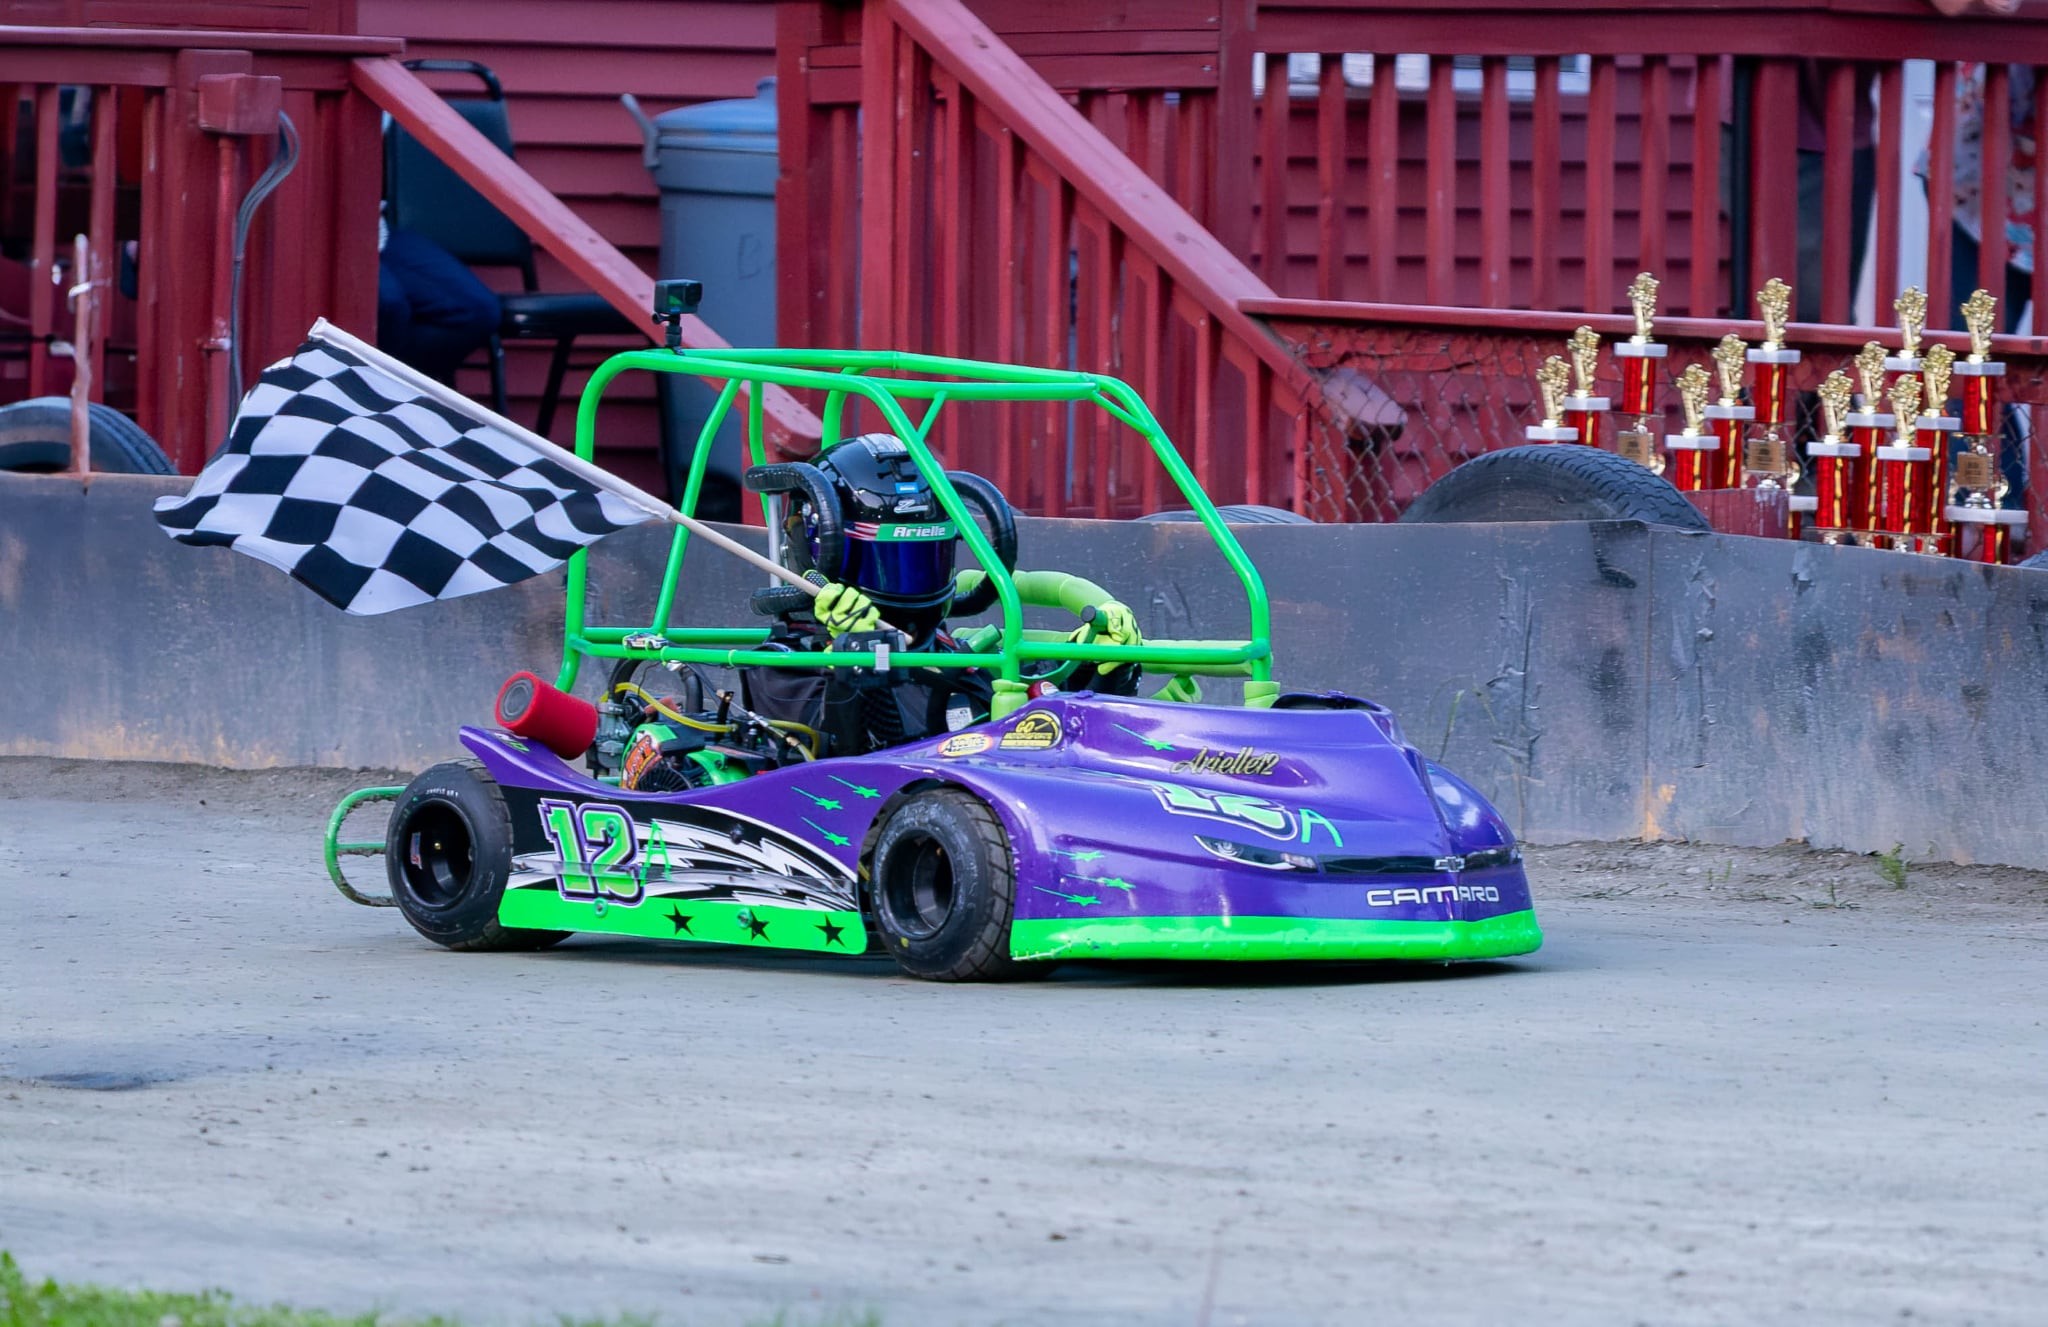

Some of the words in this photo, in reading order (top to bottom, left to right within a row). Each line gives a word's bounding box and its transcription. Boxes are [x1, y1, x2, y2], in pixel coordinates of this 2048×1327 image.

[893, 525, 946, 538] Arielle
[546, 802, 641, 905] 12
[1366, 885, 1500, 907] CAMARO
